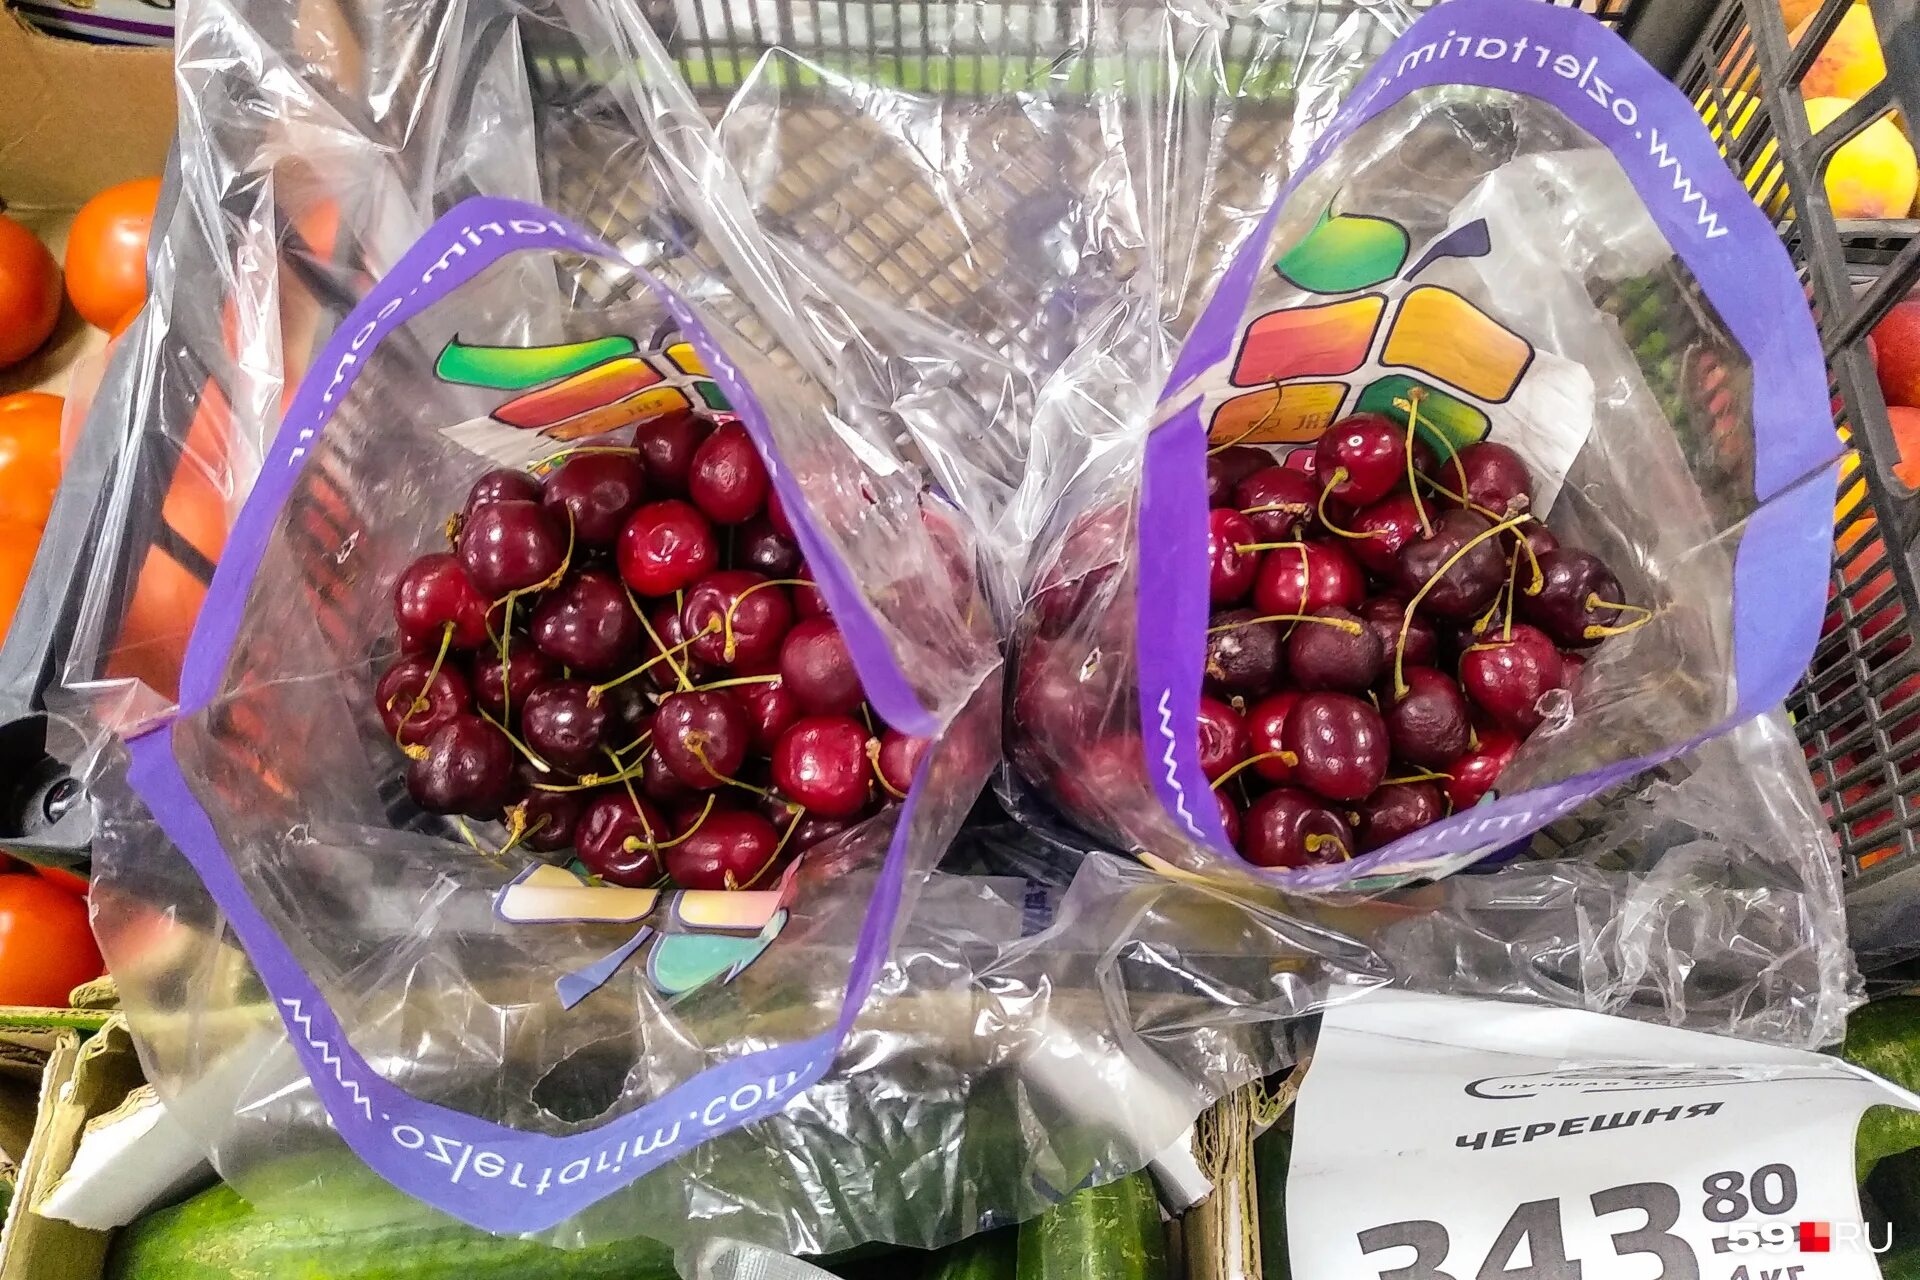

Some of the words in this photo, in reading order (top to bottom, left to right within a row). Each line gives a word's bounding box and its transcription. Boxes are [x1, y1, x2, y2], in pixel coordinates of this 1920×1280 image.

[1454, 1101, 1726, 1151] ЧЕРЕШНЯ
[1356, 1181, 1701, 1280] 343
[1702, 1162, 1798, 1223] 80
